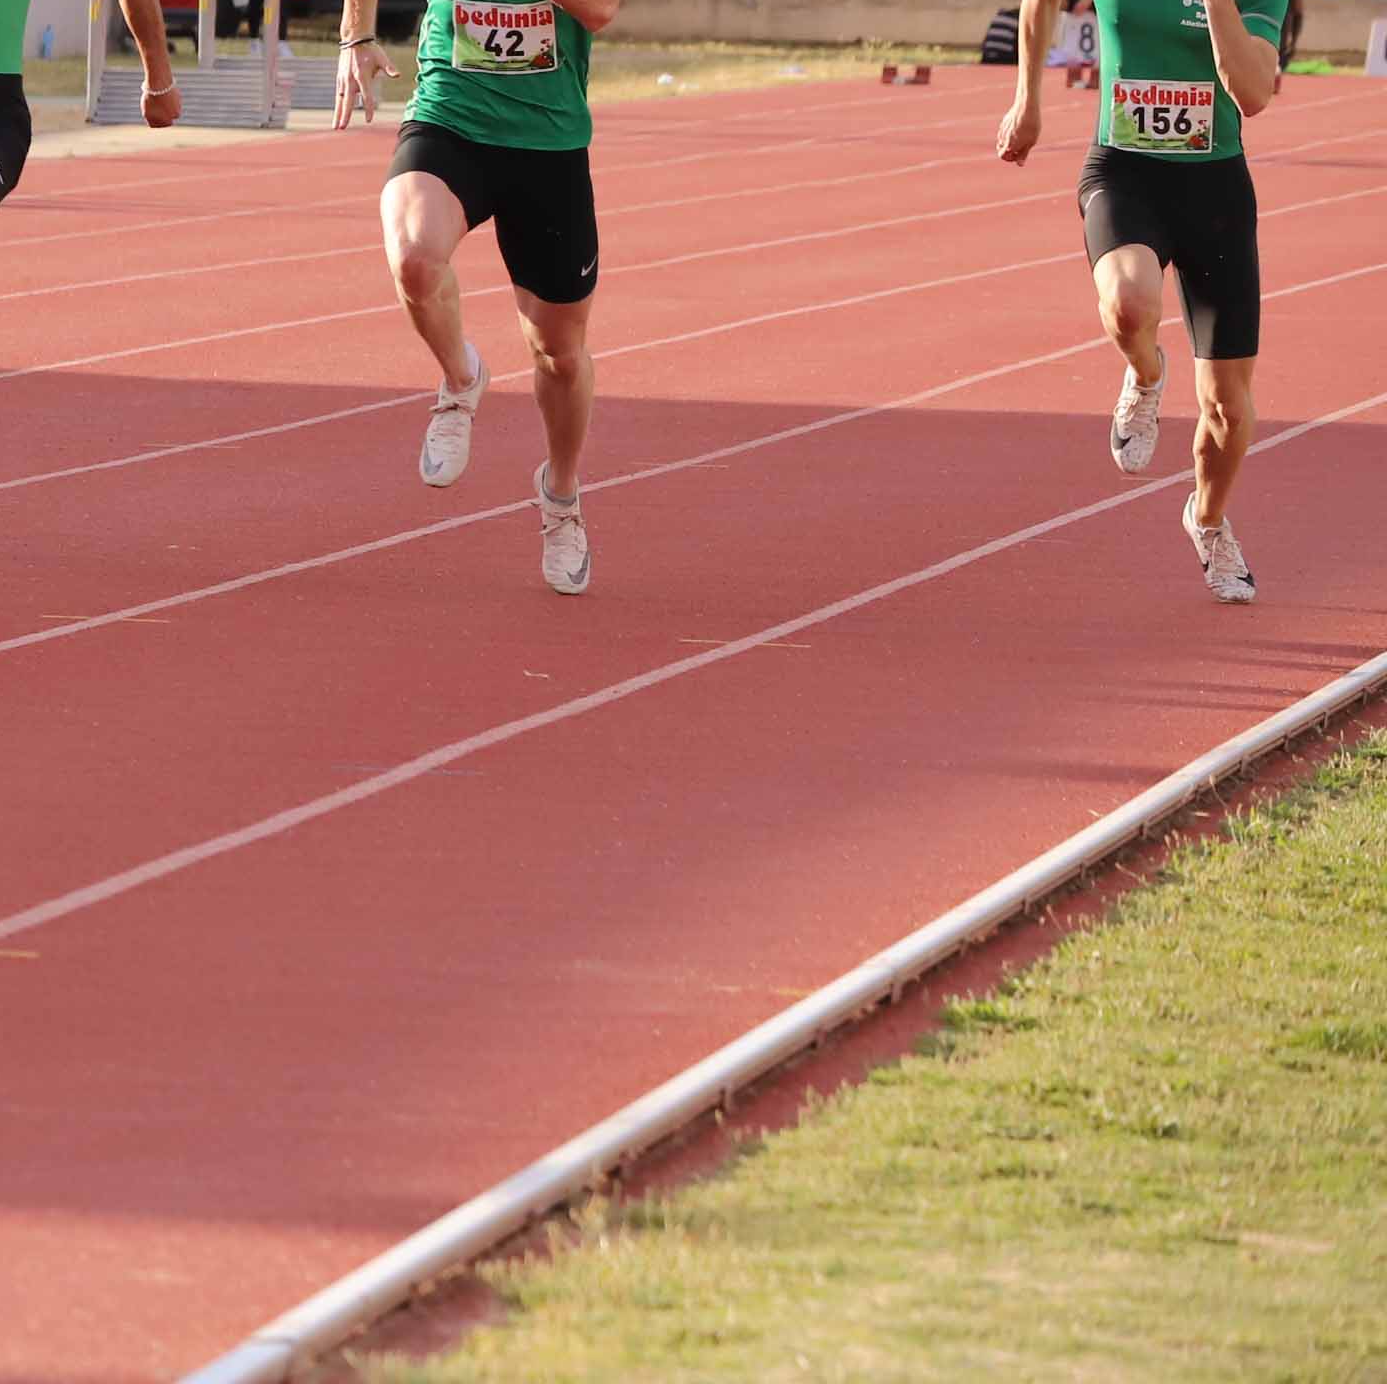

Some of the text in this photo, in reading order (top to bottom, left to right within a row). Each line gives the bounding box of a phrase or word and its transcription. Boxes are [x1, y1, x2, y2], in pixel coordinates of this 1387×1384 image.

[455, 4, 553, 29] bedunia
[484, 29, 525, 57] 42
[1079, 23, 1094, 53] 8
[1114, 83, 1212, 106] bedunia
[1132, 106, 1192, 135] 156
